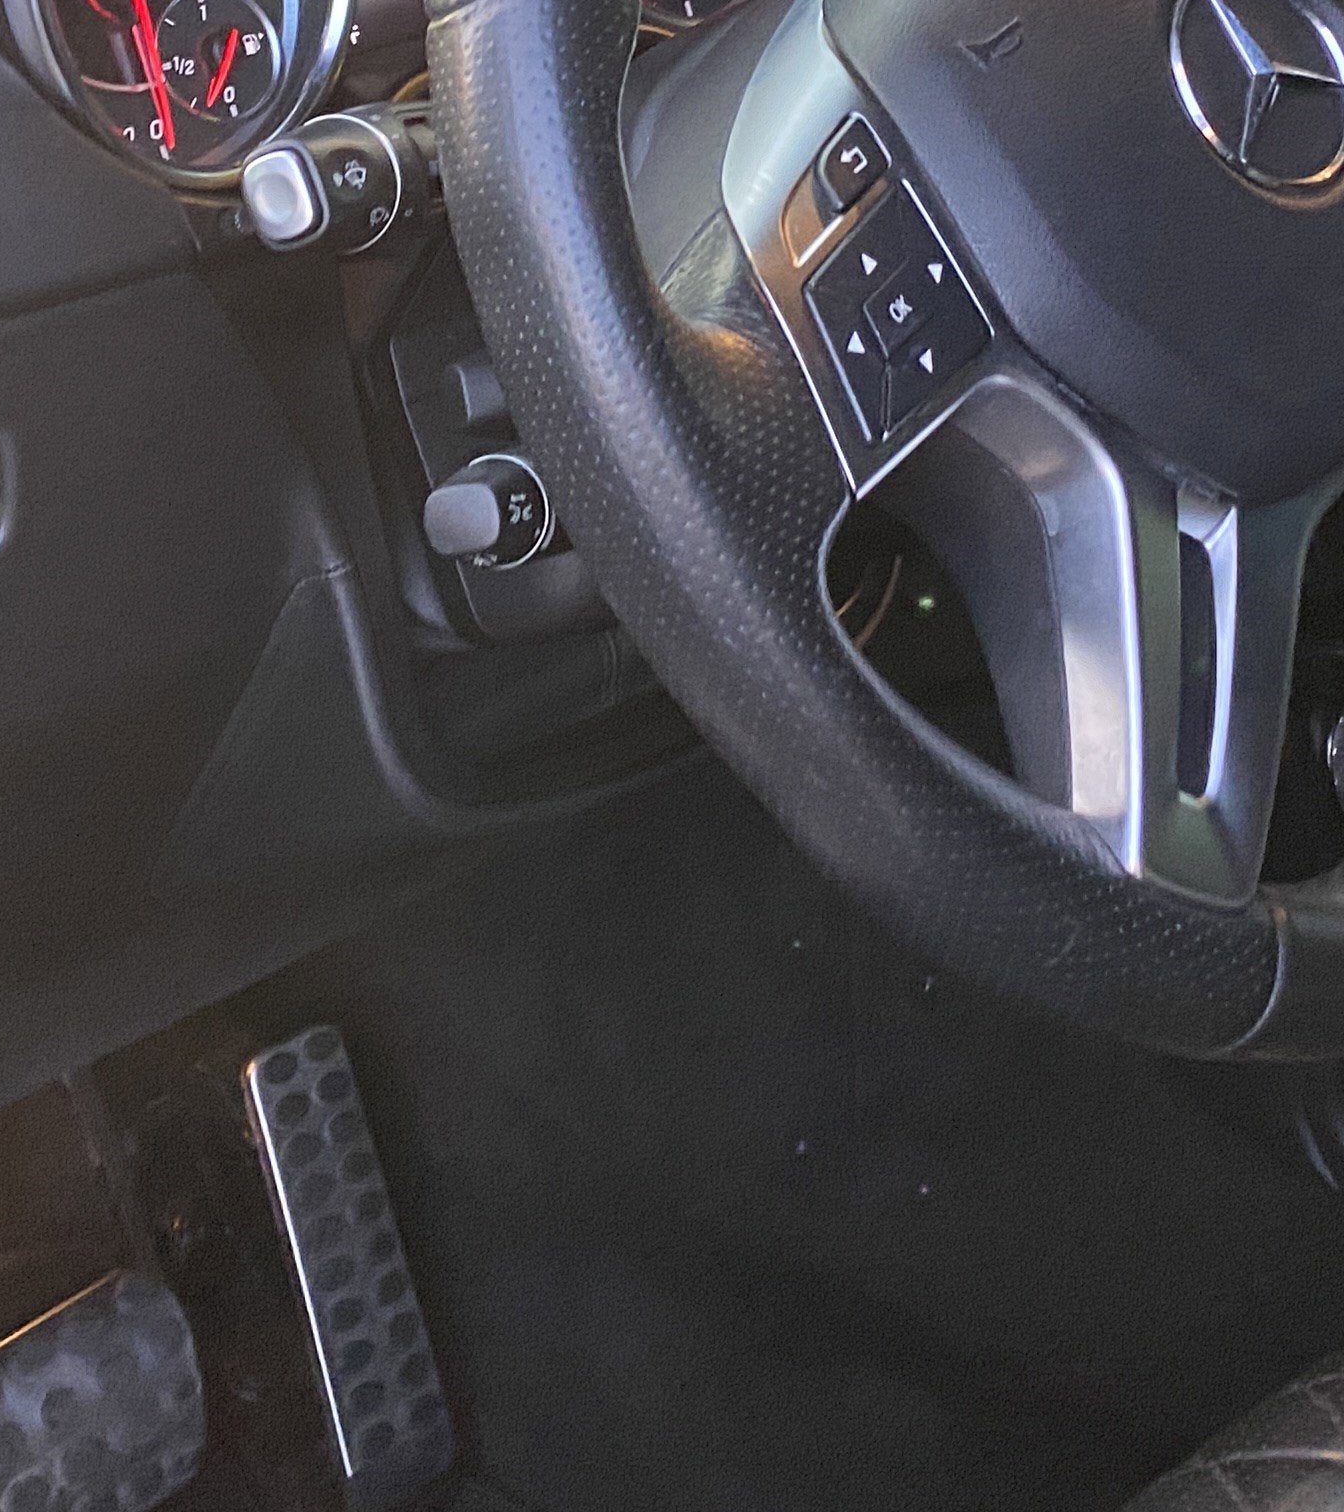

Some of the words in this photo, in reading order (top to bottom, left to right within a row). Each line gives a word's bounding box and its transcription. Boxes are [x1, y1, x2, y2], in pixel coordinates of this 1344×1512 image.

[199, 4, 207, 22] 1
[172, 55, 195, 76] 1/2
[223, 85, 236, 104] 0
[149, 118, 164, 141] 0
